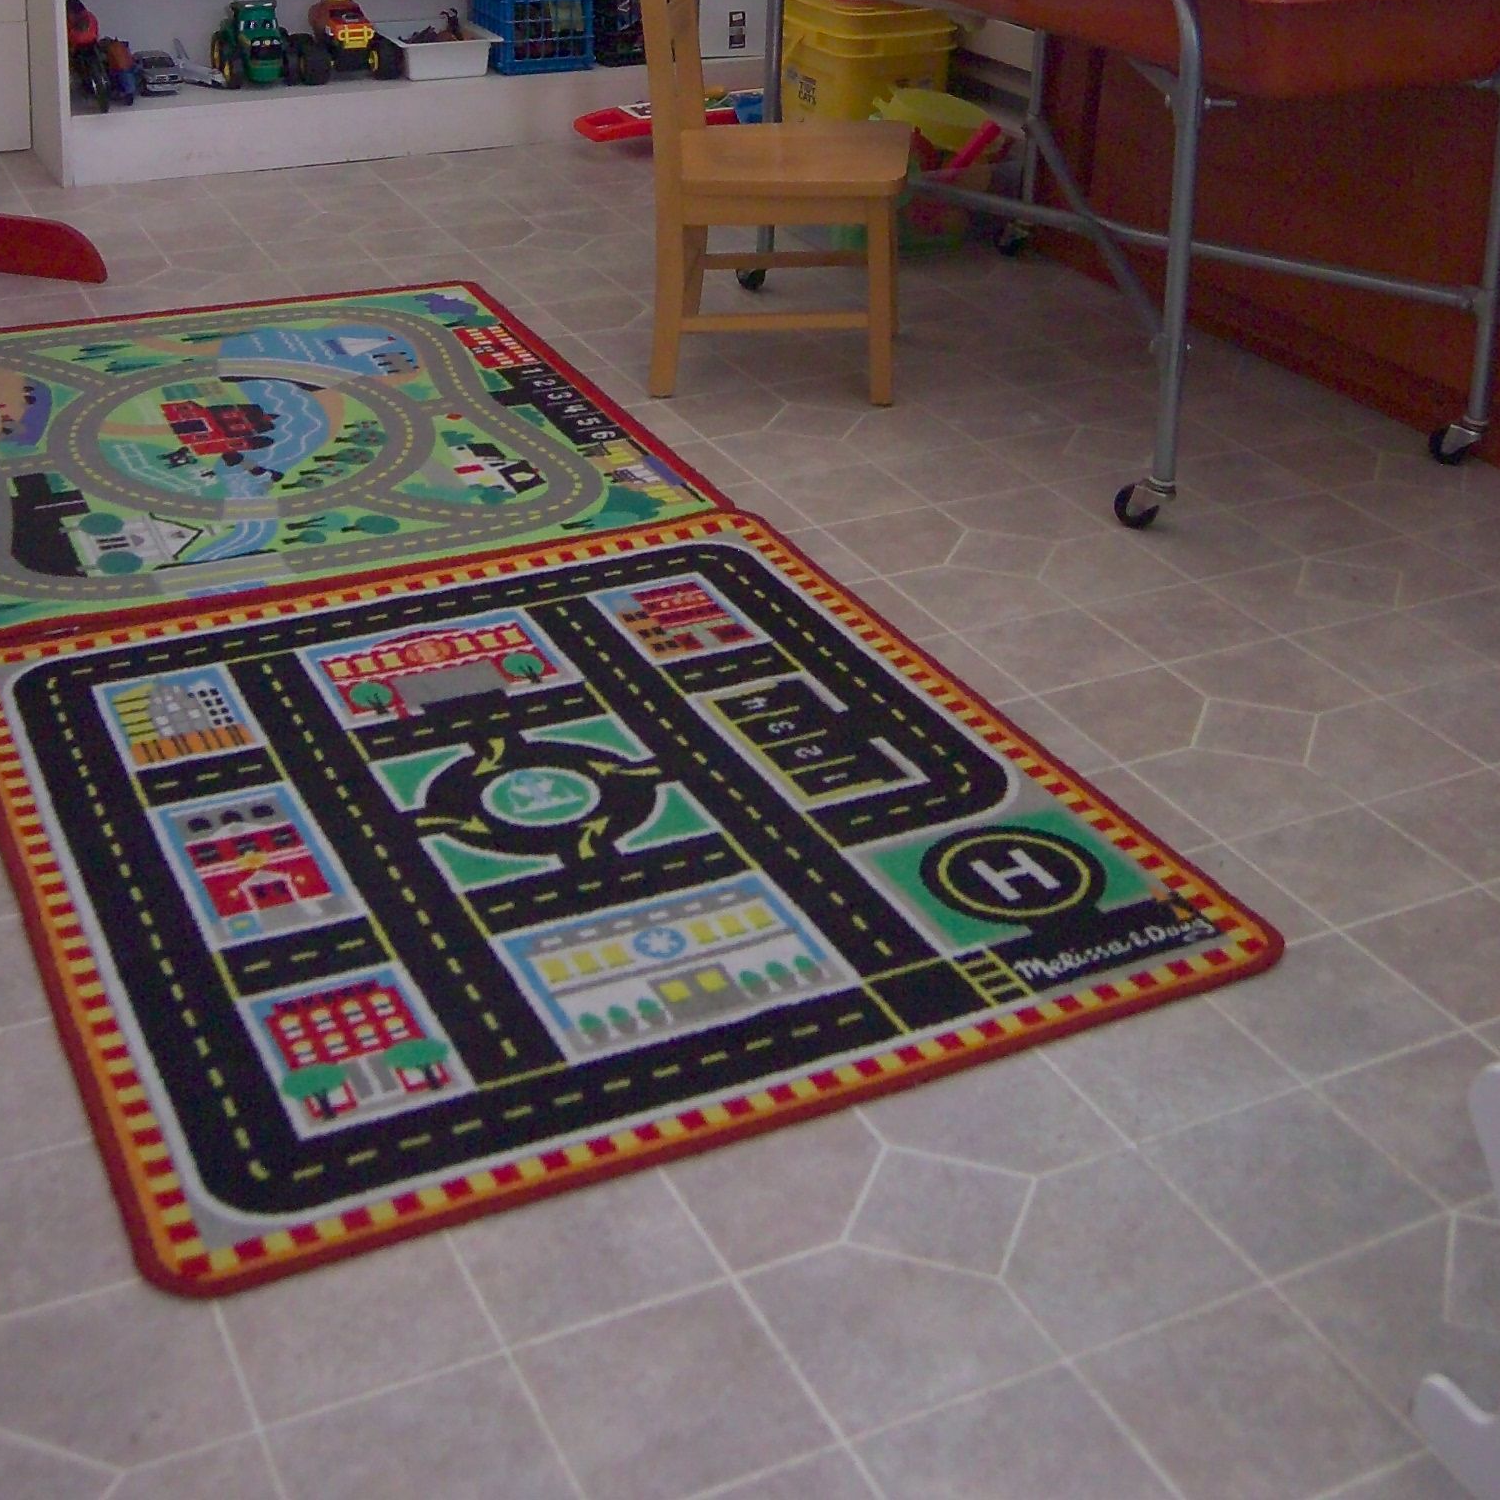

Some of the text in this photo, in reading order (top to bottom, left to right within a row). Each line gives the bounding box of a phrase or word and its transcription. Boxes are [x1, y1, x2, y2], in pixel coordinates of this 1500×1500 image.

[532, 378, 556, 388] 2
[547, 391, 573, 400] 3
[563, 403, 588, 413] 4
[576, 416, 602, 426] 5
[590, 430, 616, 440] 6
[741, 696, 768, 711] 4
[767, 719, 797, 735] 3
[793, 744, 824, 760] 2
[821, 771, 849, 784] 1
[969, 847, 1062, 901] H
[1012, 939, 1132, 980] Melissa
[1144, 917, 1216, 944] Doug
